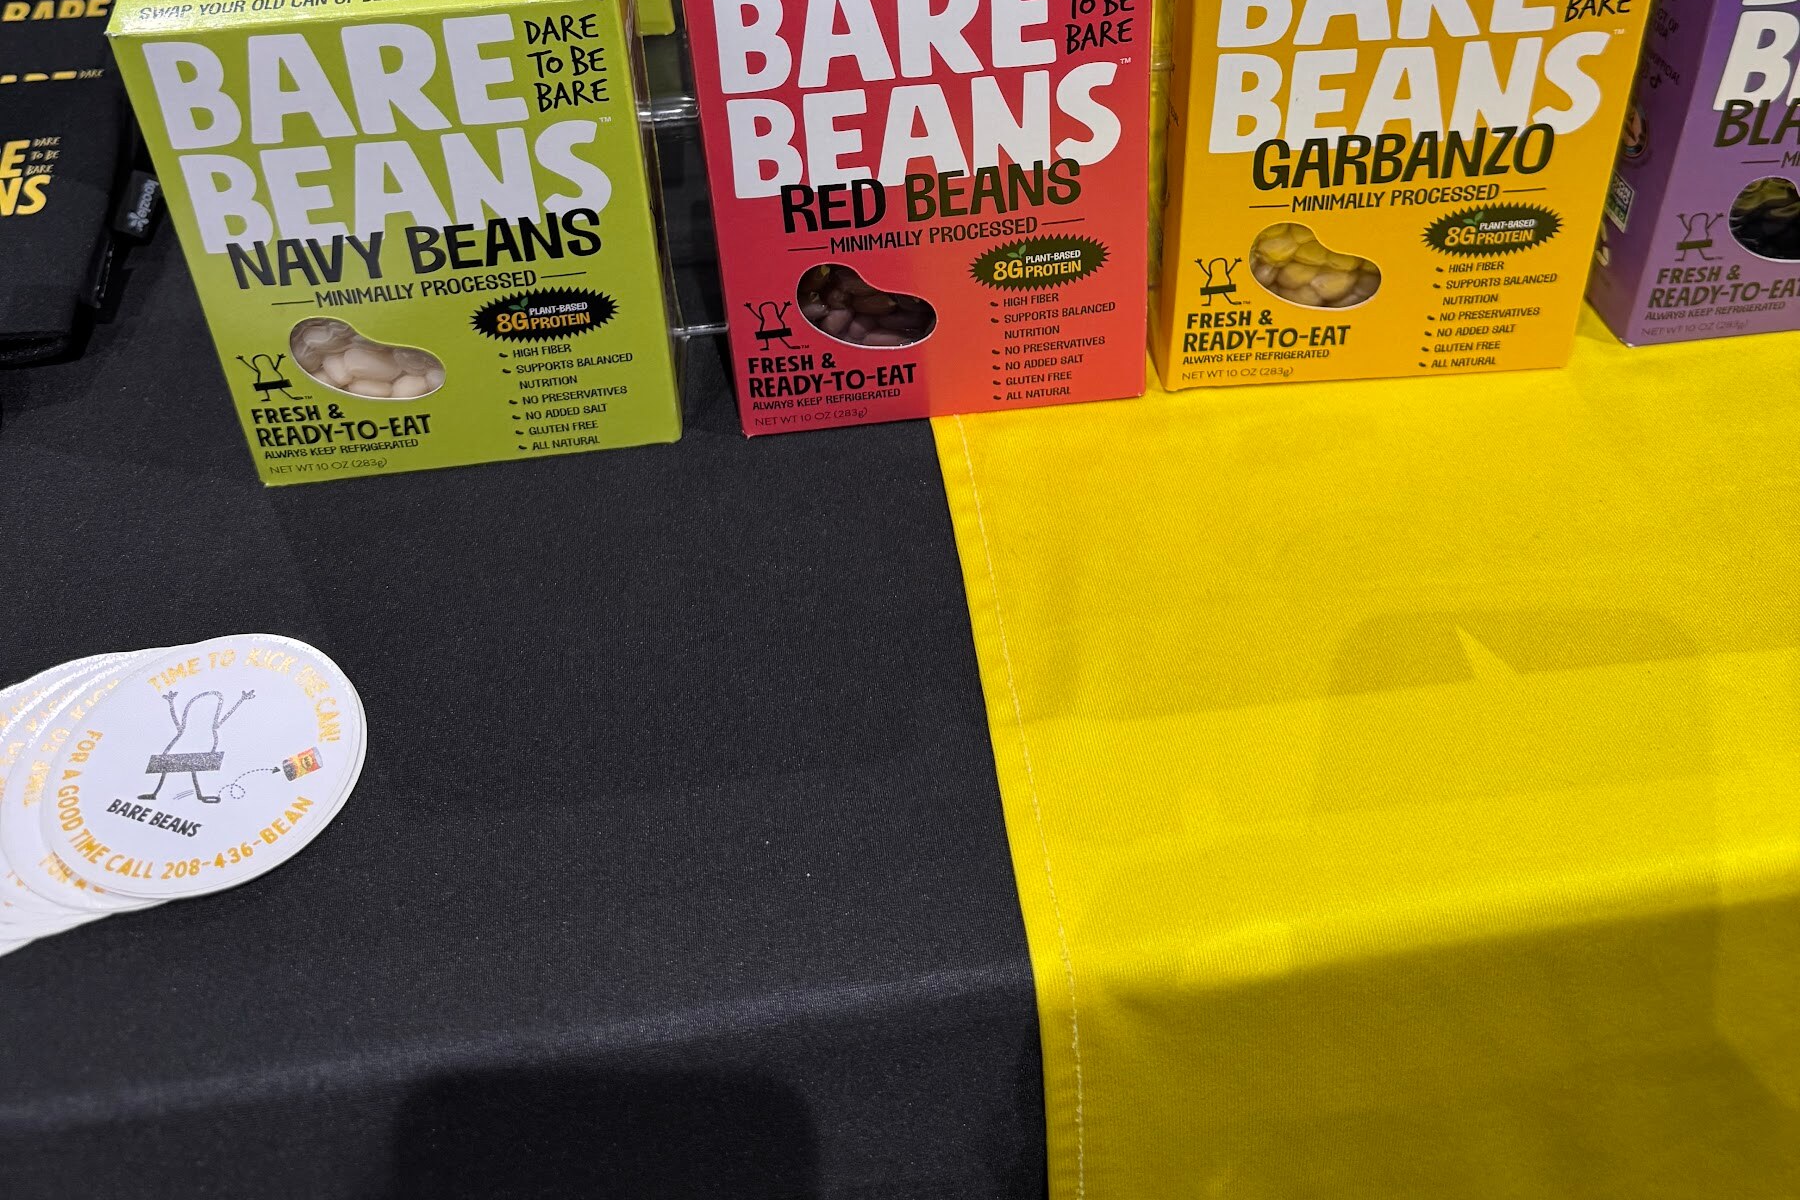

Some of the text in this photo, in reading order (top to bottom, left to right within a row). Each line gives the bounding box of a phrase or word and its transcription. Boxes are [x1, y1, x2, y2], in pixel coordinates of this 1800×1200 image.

[141, 13, 530, 150] BARE
[1208, 30, 1612, 154] BEANS
[726, 60, 1122, 199] BEANS
[32, 136, 61, 147] DARE
[44, 150, 60, 161] BE
[1251, 121, 1556, 192] GARBANZO
[25, 164, 54, 176] BARE
[177, 119, 613, 255] BEANS
[780, 158, 1082, 234] RED BEANS
[1291, 183, 1500, 213] MINIMALLY PROCESSED
[830, 216, 1039, 255] MINIMALLY PROCESSED
[1478, 217, 1535, 231] PLANT-BASED
[1444, 225, 1534, 247] 8G PROTEIN
[225, 206, 603, 290] NAVY BEANS
[1025, 249, 1082, 264] PLANT-BASED
[992, 259, 1083, 281] 8G PROTEIN
[1656, 266, 1723, 284] FRESH
[528, 301, 588, 316] PLANT-BASED
[1187, 309, 1274, 329] FRESH &
[1644, 301, 1786, 321] ALWAYS KEEP REFRIGERATED
[495, 312, 592, 334] 8G PROTEIN
[1182, 324, 1351, 353] READY-TO-EAT
[512, 343, 572, 359] HIGH FIBER
[515, 351, 634, 375] SUPPORTS BALANCED
[747, 352, 836, 375] FRESH &
[519, 374, 578, 390] NUTRITION
[749, 362, 917, 399] READY-TO-EAT
[522, 385, 628, 405] NO PRESERVATIVES
[251, 403, 345, 426] FRESH &
[525, 403, 609, 421] NO ADDED SALT
[256, 413, 432, 448] READY-TO-EAT
[528, 419, 599, 436] GLUTEN FREE
[263, 438, 419, 461] ALWAYS KEEP REFRIGERATED
[531, 435, 601, 451] ALL NATURAL
[269, 463, 293, 475] NET
[295, 462, 316, 473] WT
[316, 462, 329, 472] 10
[331, 460, 350, 471] OZ
[147, 657, 202, 693] TIME
[207, 648, 236, 669] TO
[244, 648, 299, 675] KICK
[71, 729, 103, 764] FOR
[62, 769, 82, 781] A
[57, 784, 81, 833] GOOD
[106, 798, 203, 838] BARE BEANS
[68, 829, 112, 864] TIME
[159, 794, 314, 880] 208-436-BEAN
[104, 854, 153, 879] CALL
